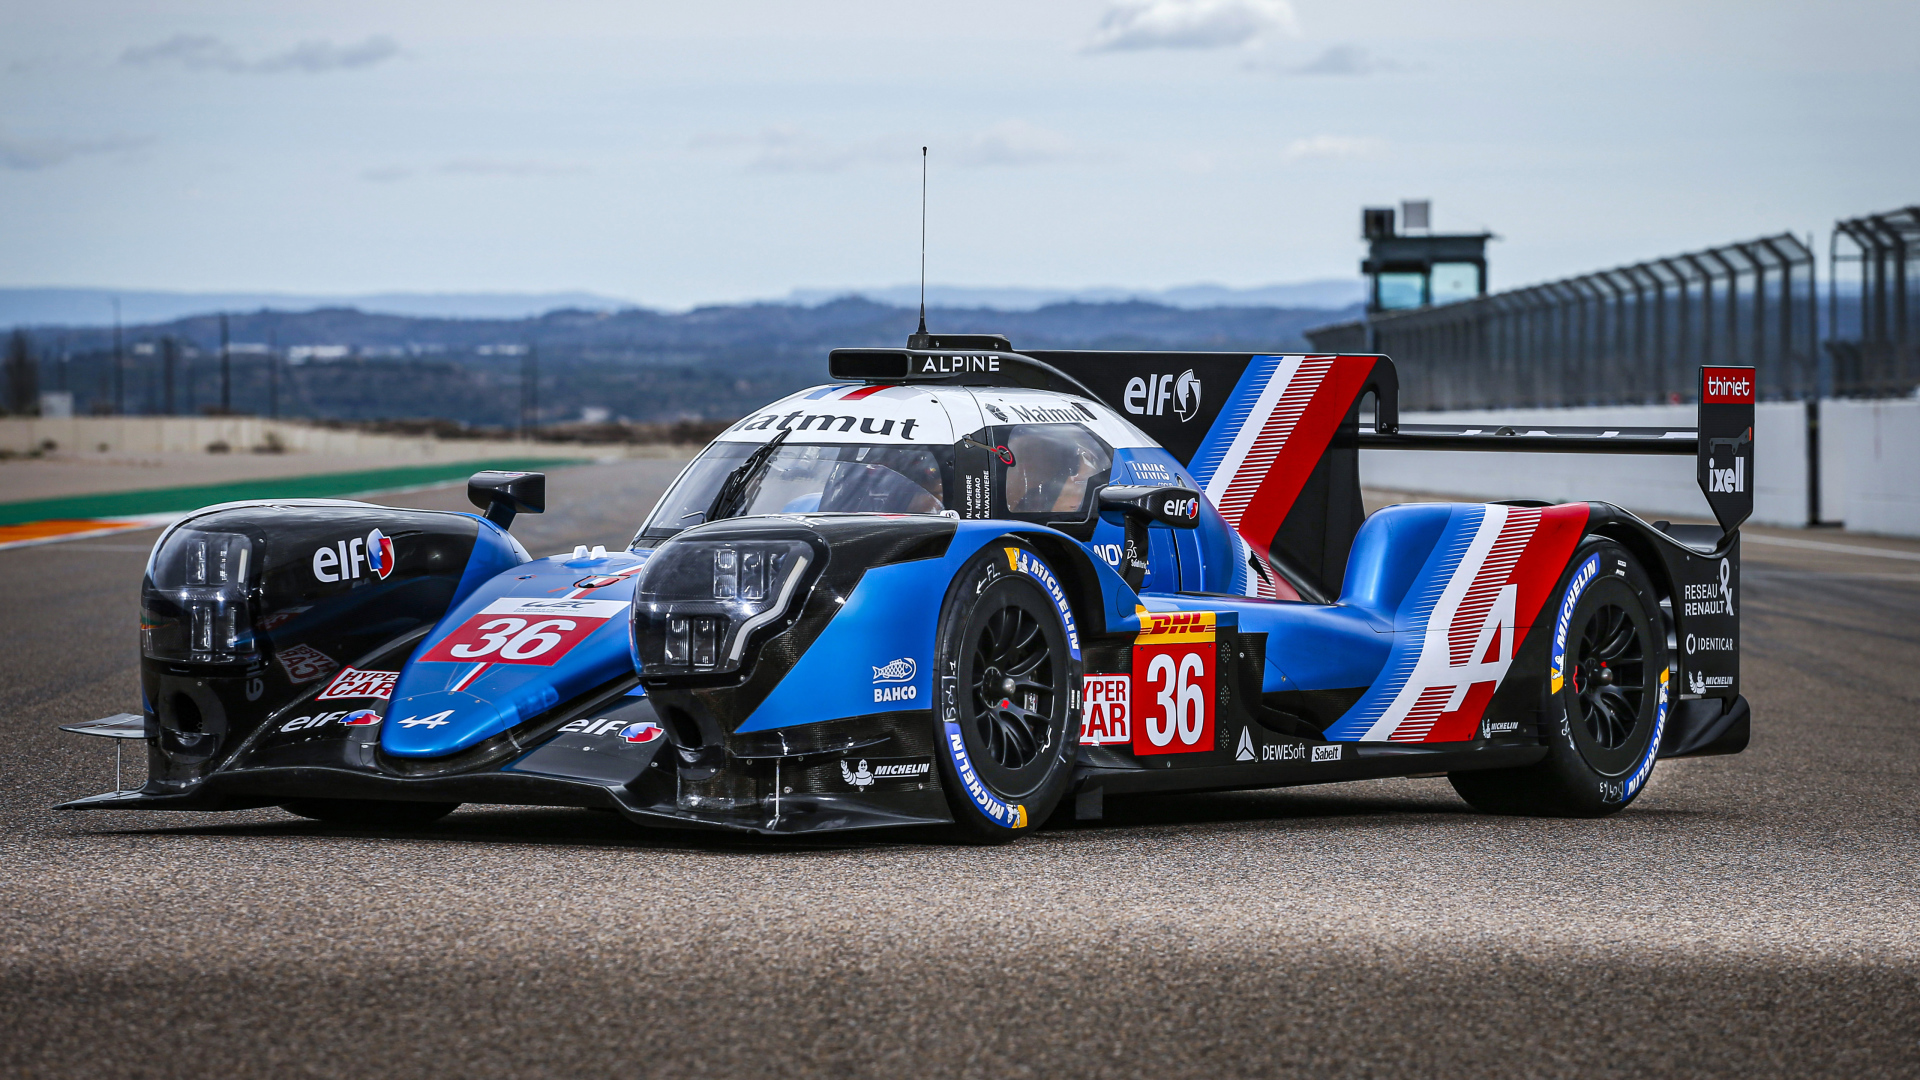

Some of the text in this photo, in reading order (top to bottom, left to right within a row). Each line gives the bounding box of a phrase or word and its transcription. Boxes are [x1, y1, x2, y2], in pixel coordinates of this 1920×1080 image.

[922, 356, 999, 372] ALPINE
[1124, 374, 1173, 416] elf
[1708, 376, 1750, 396] thiriet
[1009, 400, 1090, 422] Matmut
[1709, 456, 1744, 493] ixell
[1164, 499, 1187, 516] elf
[313, 537, 364, 582] elf
[1685, 584, 1718, 600] RESEAU
[1031, 559, 1079, 649] MICHELIN
[1557, 560, 1596, 649] MICHELIN
[1685, 601, 1725, 616] RENAULT
[1150, 613, 1206, 634] DHL
[451, 618, 577, 660] 36
[1698, 638, 1733, 650] IDENTICAR
[341, 671, 400, 681] HYPE
[1706, 676, 1733, 685] MICHELIN
[874, 686, 917, 702] BAHCO
[1145, 652, 1205, 747] 36
[280, 711, 348, 732] elf
[558, 719, 628, 735] elf
[1491, 722, 1519, 730] MICHELIN
[1262, 743, 1305, 760] DEWESoft
[1315, 747, 1339, 760] Sabelt
[1628, 708, 1666, 796] MICHELIN
[875, 763, 930, 775] MICHELIN
[950, 734, 1005, 819] MICHELIN
